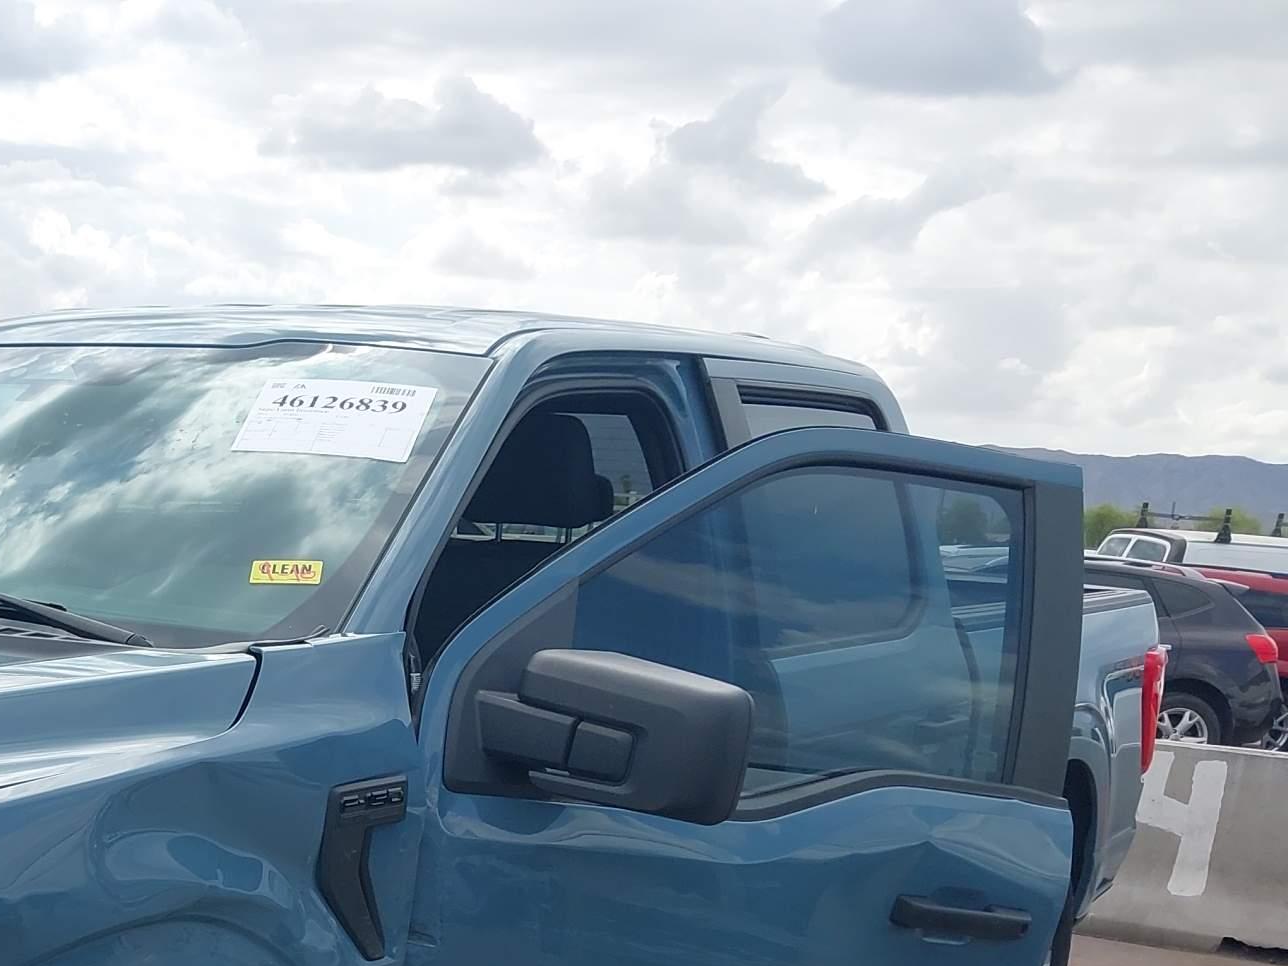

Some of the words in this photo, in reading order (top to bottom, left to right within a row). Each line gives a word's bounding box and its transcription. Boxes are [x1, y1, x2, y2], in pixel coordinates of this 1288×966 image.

[271, 394, 408, 415] 46126839
[260, 563, 313, 575] CLEAN
[1134, 750, 1228, 896] 4
